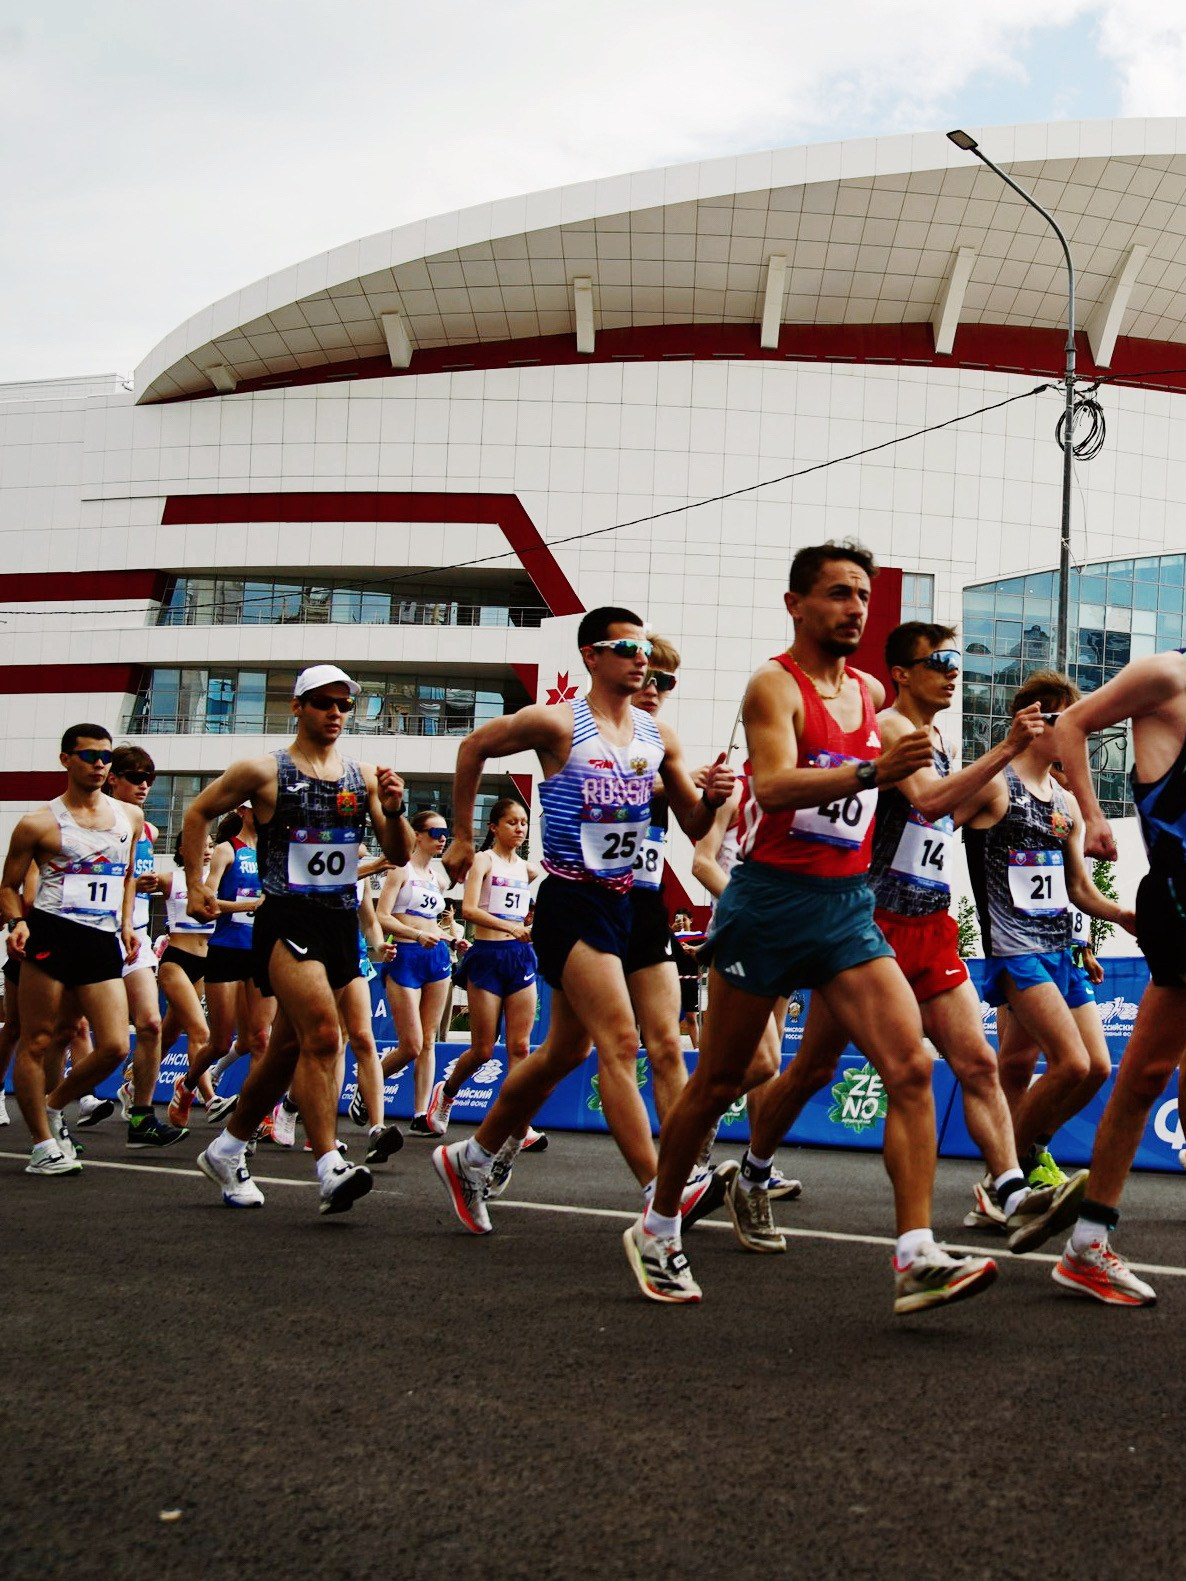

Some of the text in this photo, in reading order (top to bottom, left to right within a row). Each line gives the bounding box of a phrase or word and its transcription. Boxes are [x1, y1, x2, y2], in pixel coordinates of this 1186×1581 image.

[818, 793, 863, 827] 40
[602, 831, 637, 860] 25
[921, 839, 944, 871] 14
[307, 850, 345, 876] 60
[87, 881, 108, 902] 11
[1030, 874, 1052, 900] 21
[420, 894, 438, 910] 39
[504, 892, 521, 909] 51
[848, 1074, 884, 1097] ZE
[841, 1097, 879, 1120] NO
